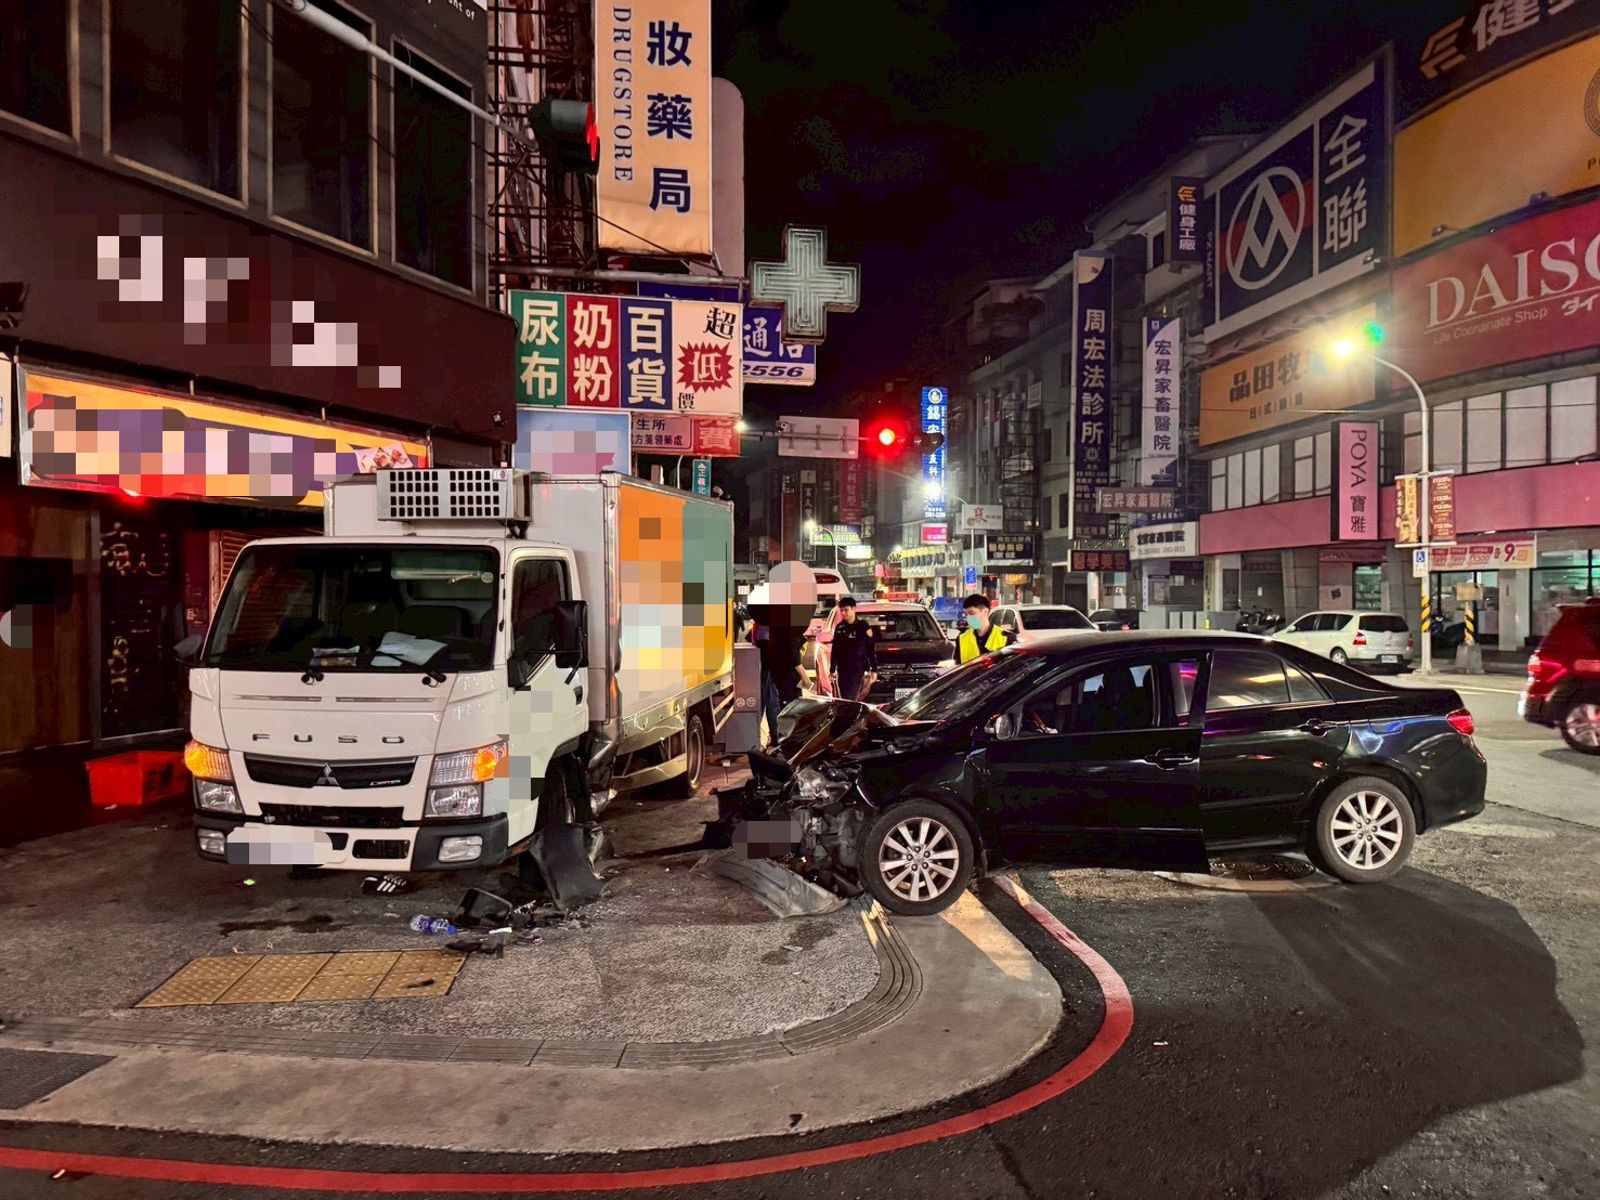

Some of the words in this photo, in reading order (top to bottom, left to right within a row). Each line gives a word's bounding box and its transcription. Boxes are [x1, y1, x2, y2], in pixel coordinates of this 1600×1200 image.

[1472, 0, 1575, 51] 健
[612, 6, 633, 182] DRUGSTORE
[646, 20, 693, 213] 妝藥局
[1179, 203, 1197, 251] 健身工廠
[1323, 113, 1368, 254] 全聯
[520, 298, 560, 400] 尿布
[573, 301, 613, 402] 奶粉
[627, 306, 666, 406] 百貨
[1515, 307, 1548, 323] Shop
[631, 419, 666, 431] 生所
[1081, 308, 1106, 444] 周宏法診所
[1153, 339, 1172, 451] 宏昇家畜醫院
[1350, 429, 1367, 487] POYA
[1350, 495, 1367, 533] 寶雅
[252, 733, 404, 744] FUSO
